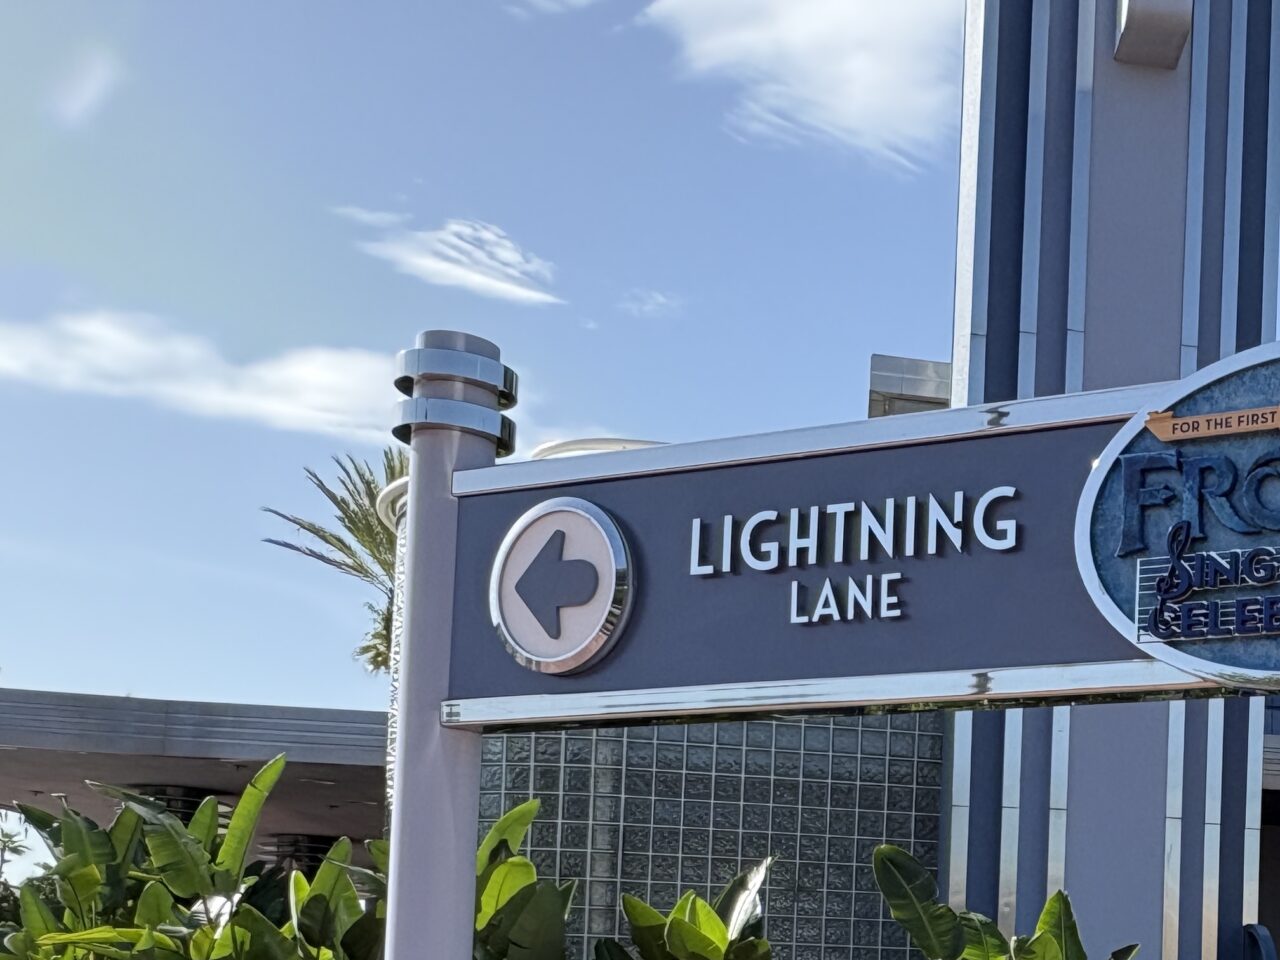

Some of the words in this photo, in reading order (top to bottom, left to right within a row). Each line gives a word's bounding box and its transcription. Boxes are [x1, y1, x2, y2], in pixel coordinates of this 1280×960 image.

[1172, 420, 1200, 434] FOR
[1206, 417, 1233, 430] THE
[1237, 411, 1278, 426] FIRST
[690, 486, 1017, 575] LIGHTNING
[790, 572, 902, 623] LANE
